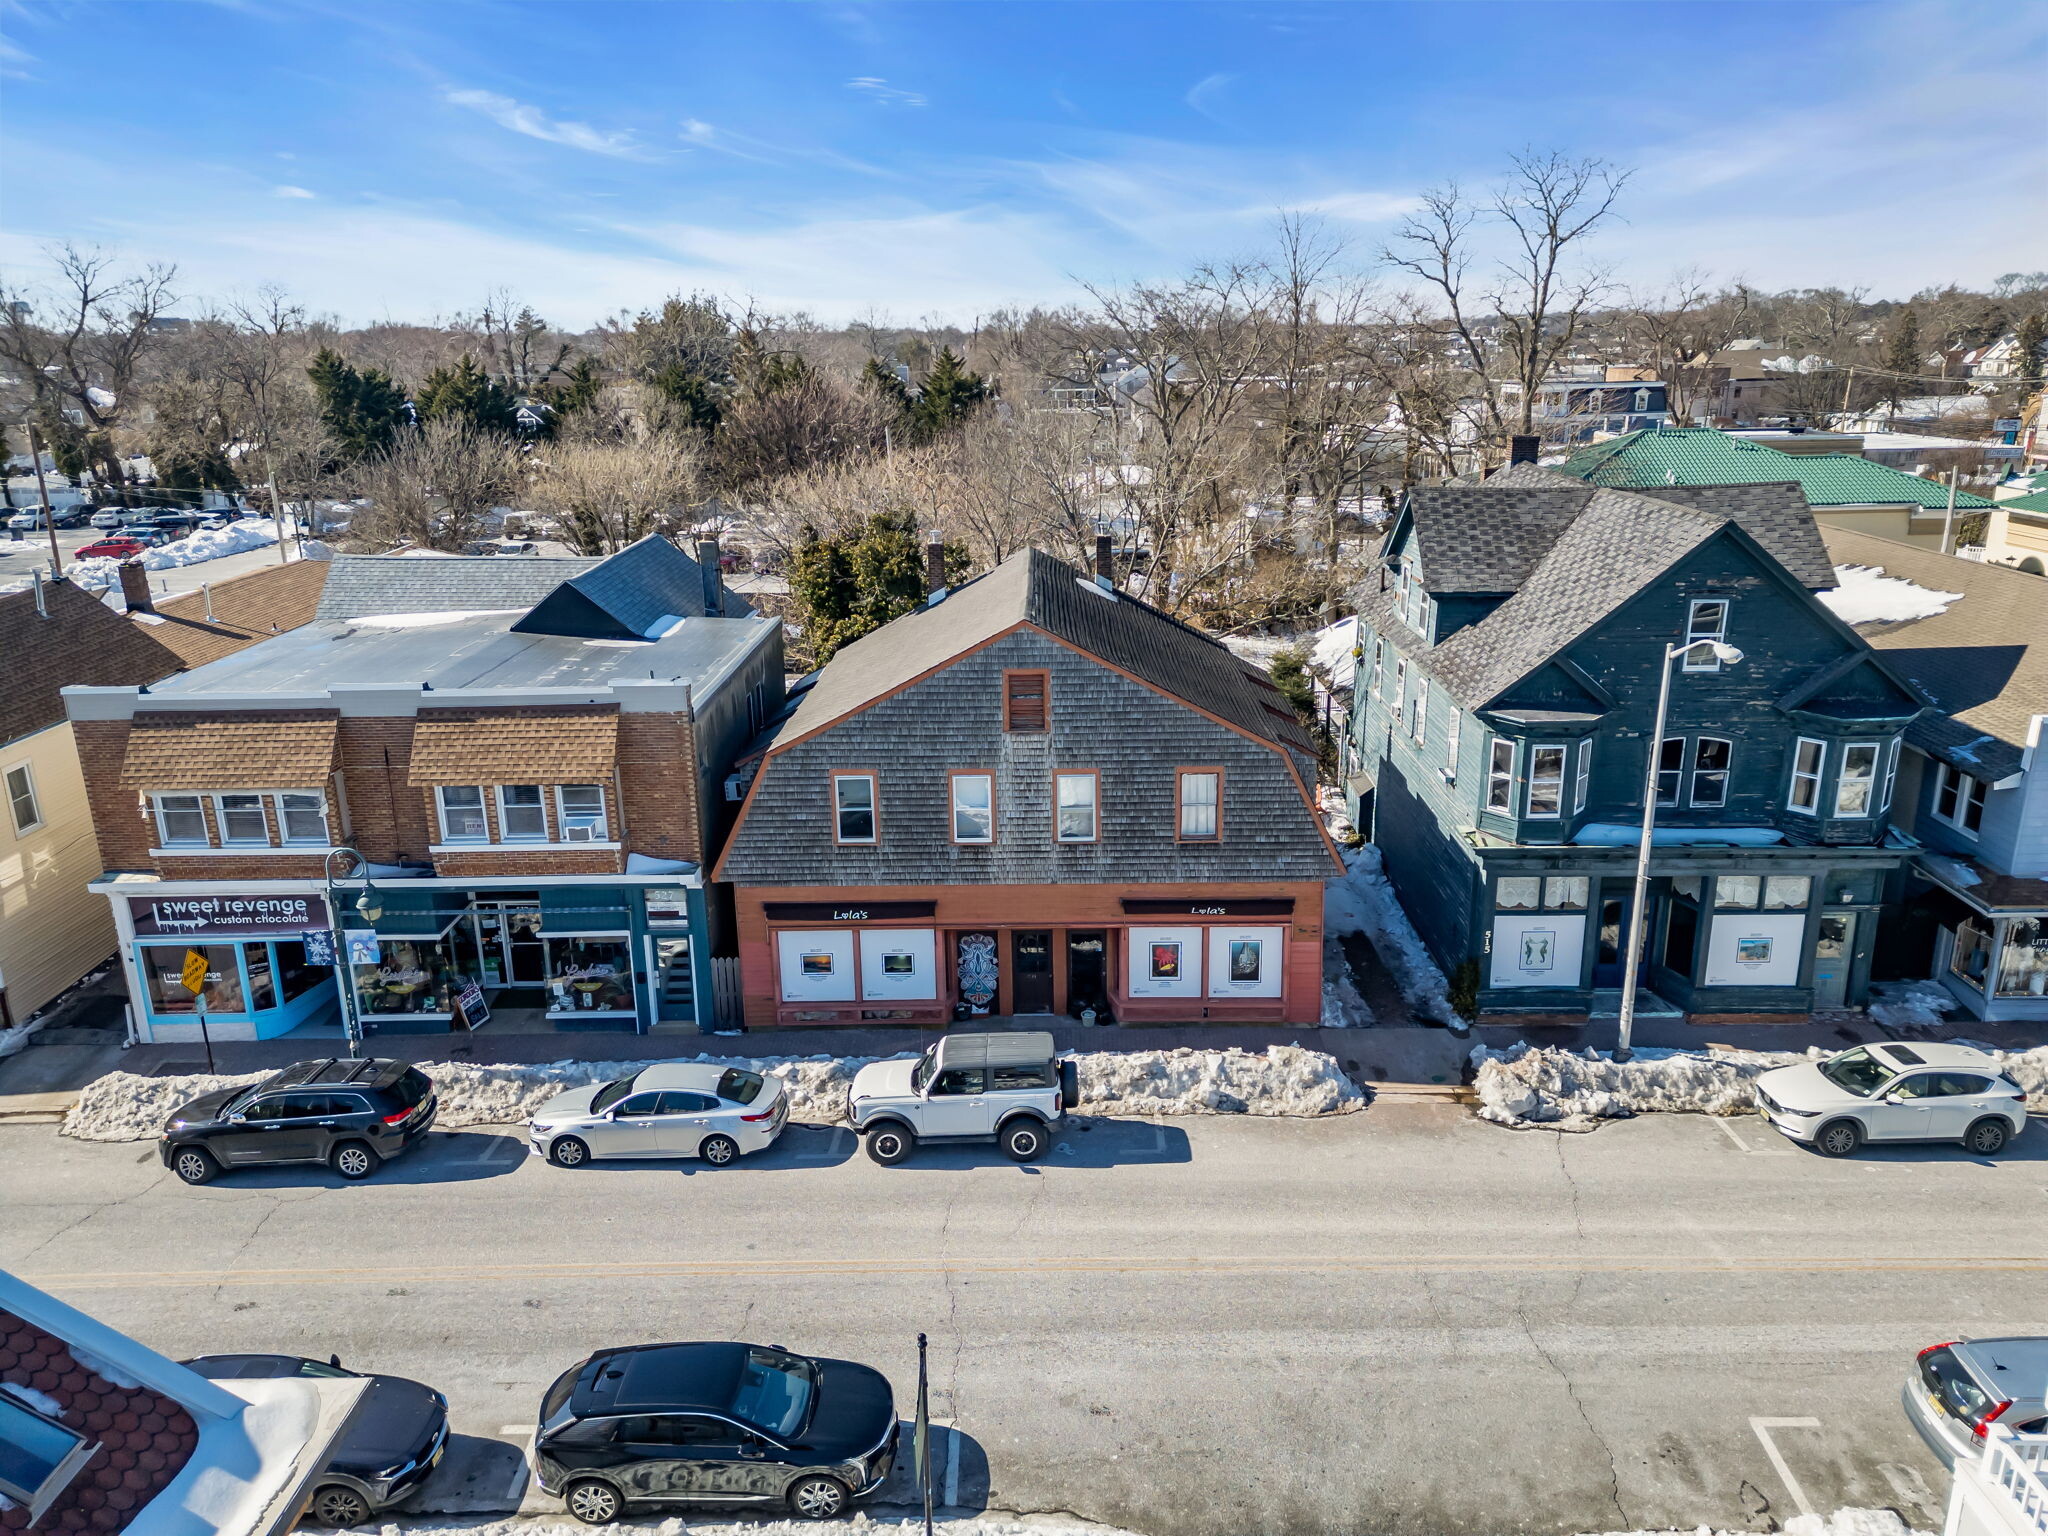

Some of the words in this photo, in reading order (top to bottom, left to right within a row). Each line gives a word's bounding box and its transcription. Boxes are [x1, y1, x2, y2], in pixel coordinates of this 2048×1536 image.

[162, 898, 220, 914] sweet
[225, 899, 307, 915] revenge
[214, 915, 252, 924] custom
[255, 913, 309, 924] chocolate
[833, 909, 869, 920] Lola's
[1483, 930, 1492, 954] 515
